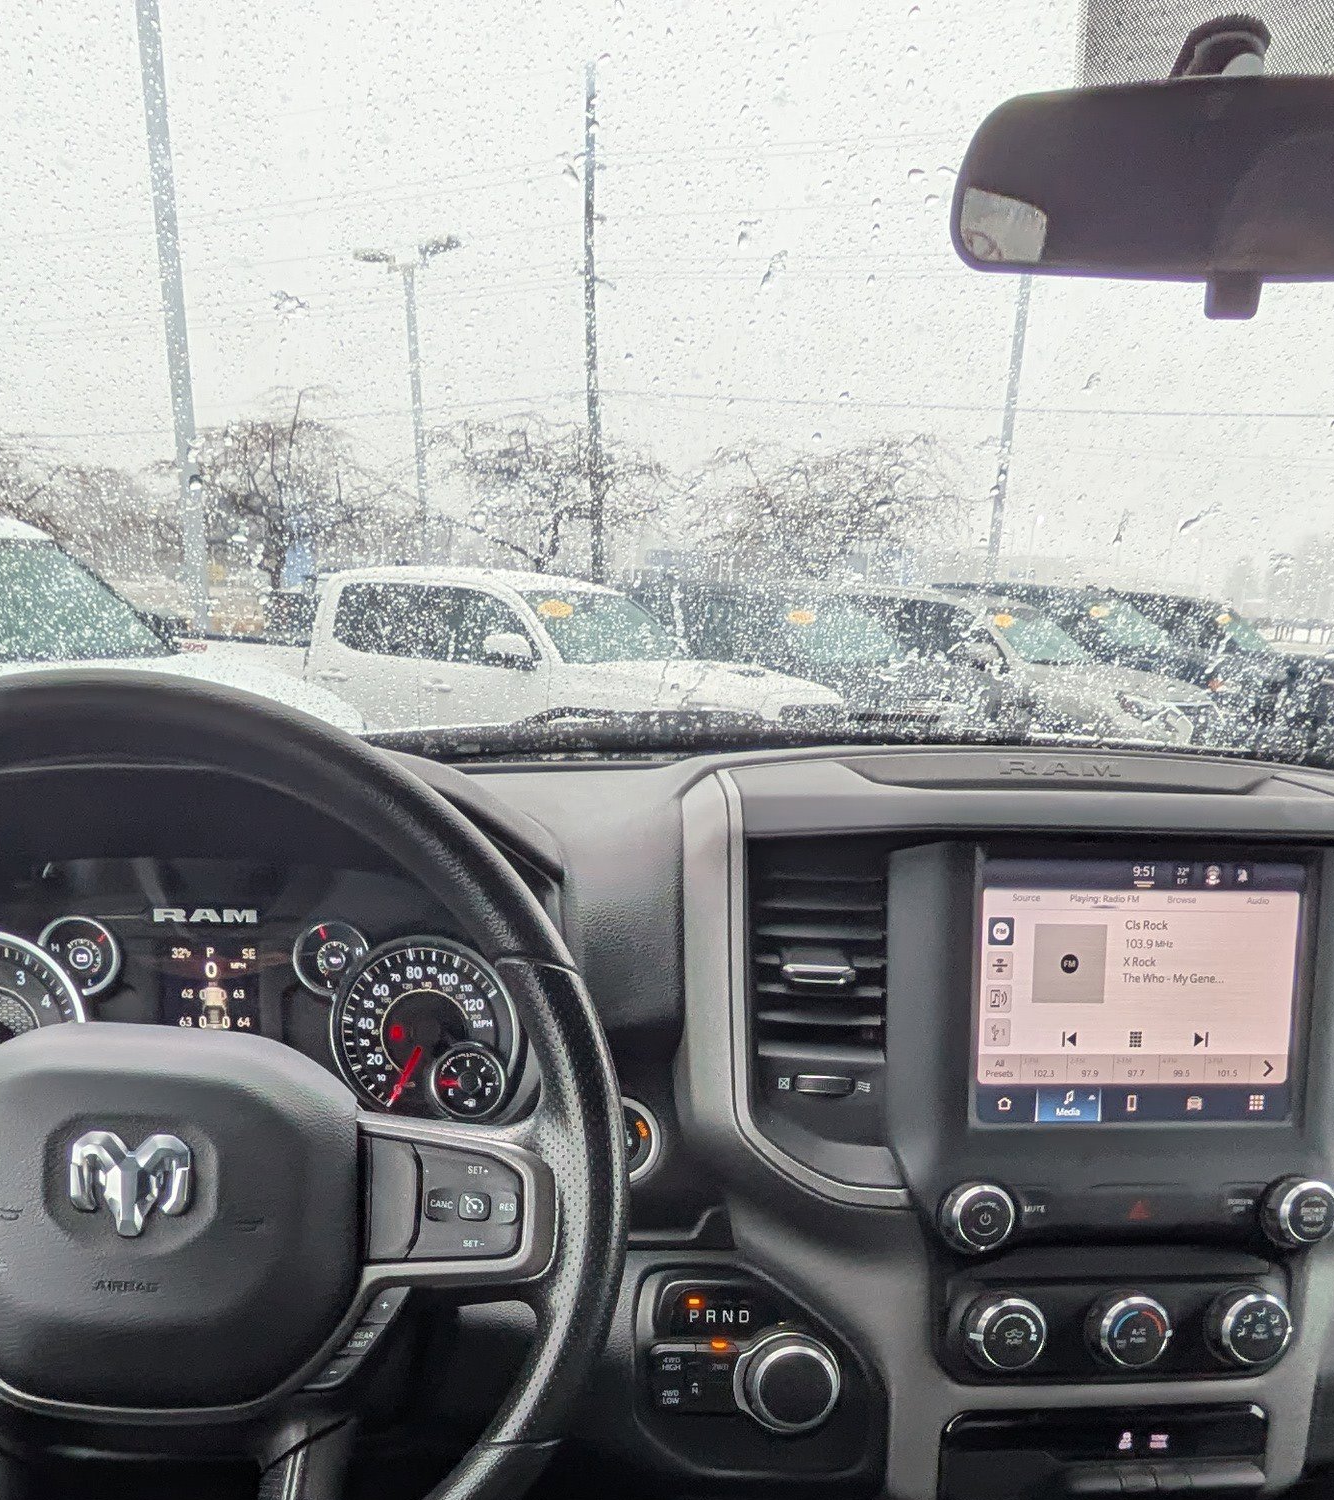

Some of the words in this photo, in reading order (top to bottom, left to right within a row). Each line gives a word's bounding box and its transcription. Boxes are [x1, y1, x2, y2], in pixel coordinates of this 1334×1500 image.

[998, 758, 1121, 777] RAM
[1132, 865, 1155, 877] 9:51
[1012, 894, 1041, 903] Source
[1069, 894, 1100, 904] Playing:
[1103, 895, 1125, 904] Radio
[1127, 895, 1140, 903] FM
[1167, 896, 1197, 905] Browse
[1246, 897, 1269, 906] Audio
[153, 908, 258, 923] RAM
[1143, 920, 1168, 931] Rock
[1125, 938, 1153, 949] 103.9
[207, 947, 214, 958] P
[242, 947, 256, 959] SE
[1063, 960, 1076, 968] FM
[1123, 957, 1131, 967] X
[1132, 957, 1156, 967] Rock
[205, 961, 218, 978] 0
[406, 966, 423, 980] 80
[427, 966, 437, 975] 90
[17, 970, 26, 986] 3
[437, 973, 459, 986] 100
[1123, 973, 1141, 984] The
[1142, 974, 1165, 984] Who
[1173, 974, 1188, 985] My
[181, 988, 194, 999] 62
[233, 989, 245, 999] 63
[372, 984, 389, 997] 60
[41, 994, 51, 1009] 4
[363, 1000, 375, 1009] 50
[463, 998, 485, 1012] 120
[179, 1016, 192, 1027] 63
[237, 1017, 250, 1027] 64
[357, 1018, 375, 1030] 40
[472, 1019, 493, 1029] MPH
[359, 1038, 370, 1047] 30
[367, 1053, 383, 1066] 20
[995, 1059, 1005, 1068] All
[985, 1070, 1014, 1078] Presets
[1033, 1069, 1055, 1078] 102.3
[1081, 1069, 1099, 1078] 97.9
[1127, 1069, 1146, 1078] 97.7
[1056, 1106, 1081, 1117] Media
[430, 1199, 454, 1209] CANC
[499, 1203, 515, 1212] RES
[1024, 1205, 1046, 1213] MUTE
[689, 1310, 699, 1322] P
[706, 1310, 716, 1322] R
[722, 1310, 733, 1322] N
[739, 1310, 750, 1322] D
[353, 1331, 374, 1339] GEAR
[662, 1363, 681, 1371] HIGH
[662, 1389, 679, 1397] 4WD
[662, 1397, 680, 1405] LOW
